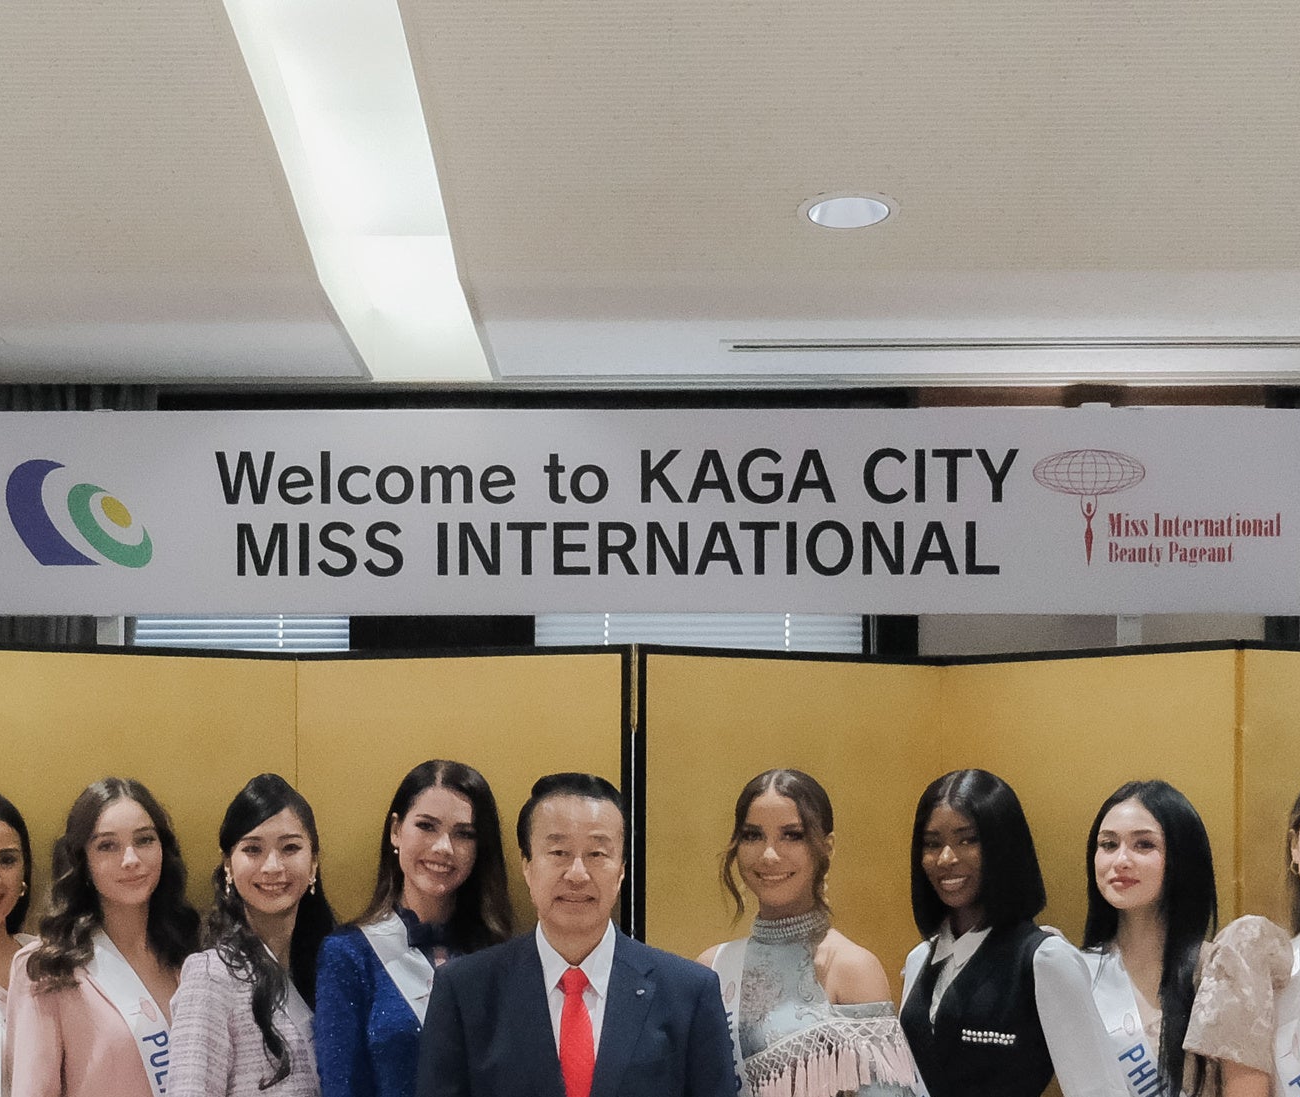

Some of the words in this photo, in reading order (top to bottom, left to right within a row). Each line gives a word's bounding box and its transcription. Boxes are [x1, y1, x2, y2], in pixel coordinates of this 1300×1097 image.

[215, 450, 516, 505] Welcome
[543, 452, 609, 505] to
[640, 447, 836, 504] KAGA
[863, 447, 1020, 504] CITY
[1108, 512, 1149, 538] Miss
[1153, 512, 1282, 538] International
[236, 521, 404, 577] MISS
[437, 520, 1000, 577] INTERNATIONAL
[1108, 541, 1163, 568] Beauty
[1168, 541, 1234, 568] Pageant
